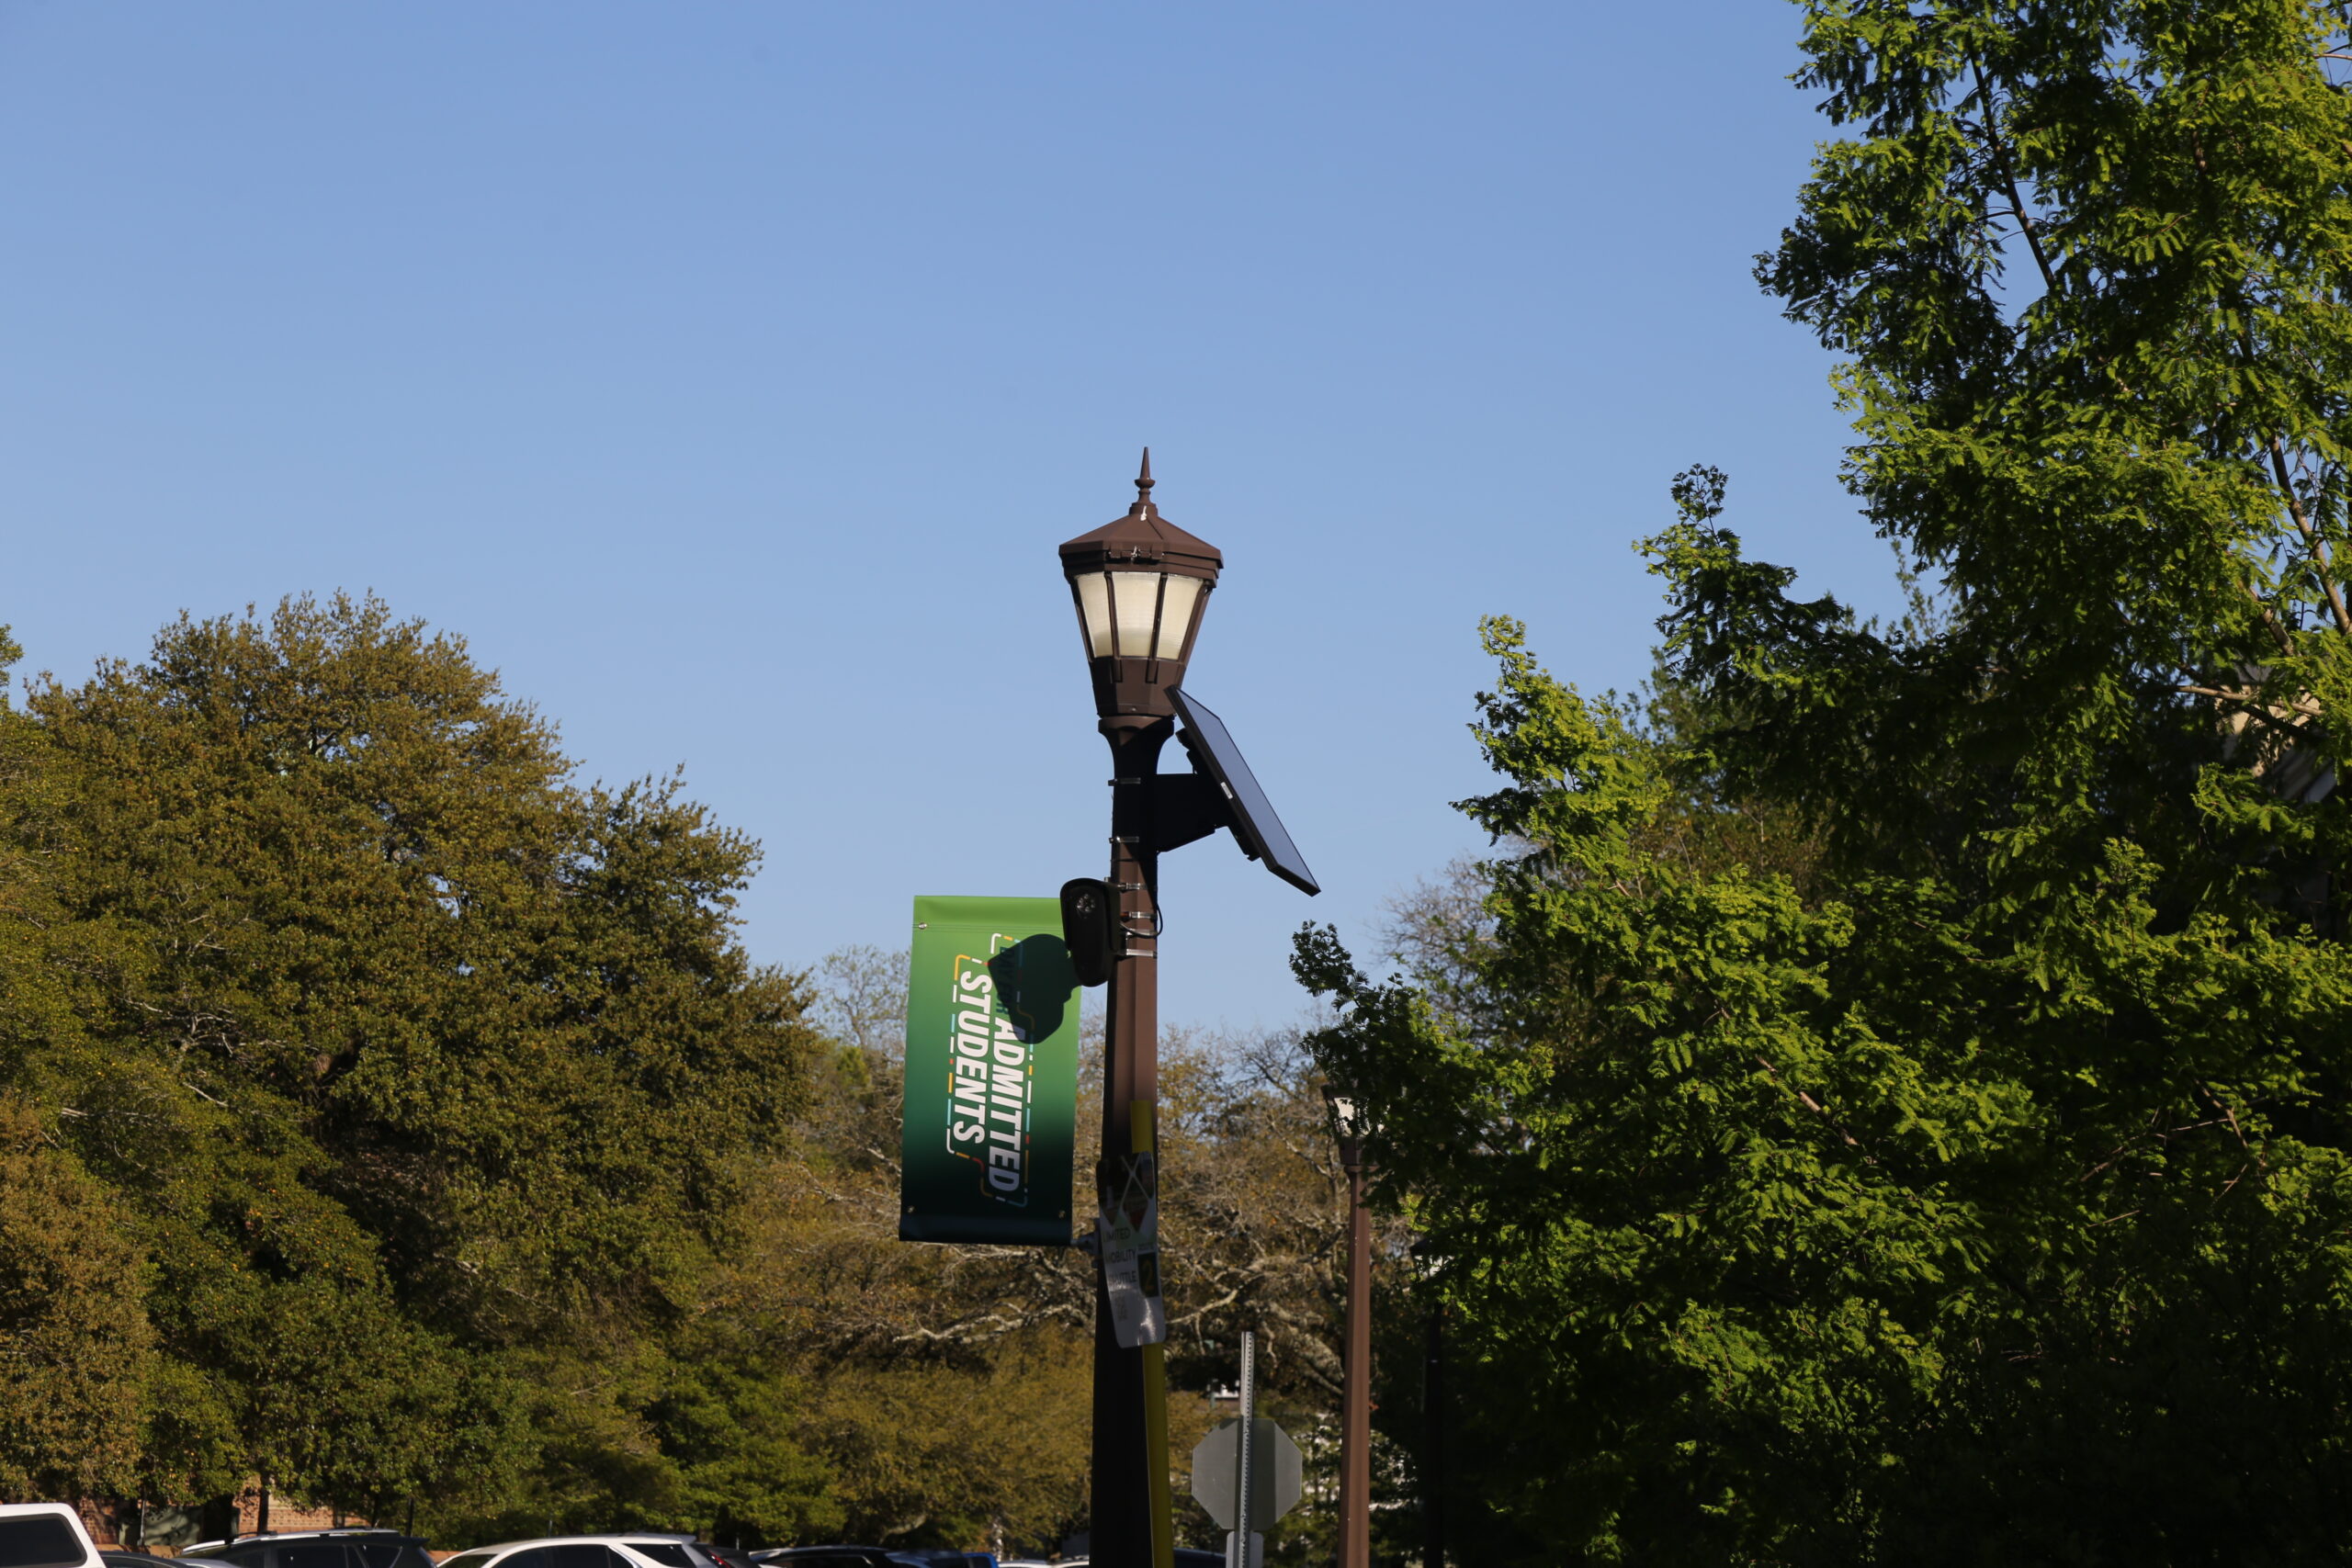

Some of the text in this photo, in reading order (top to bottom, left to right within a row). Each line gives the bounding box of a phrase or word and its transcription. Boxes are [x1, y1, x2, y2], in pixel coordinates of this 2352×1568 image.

[996, 982, 1013, 1015] FOR
[953, 971, 992, 1145] STUDENTS
[989, 1017, 1026, 1191] ADMITTED
[1102, 1227, 1131, 1242] LIMITED
[1105, 1248, 1136, 1263] MOBILITY
[1109, 1270, 1137, 1286] SHUTTLE
[1141, 1258, 1155, 1292] 2
